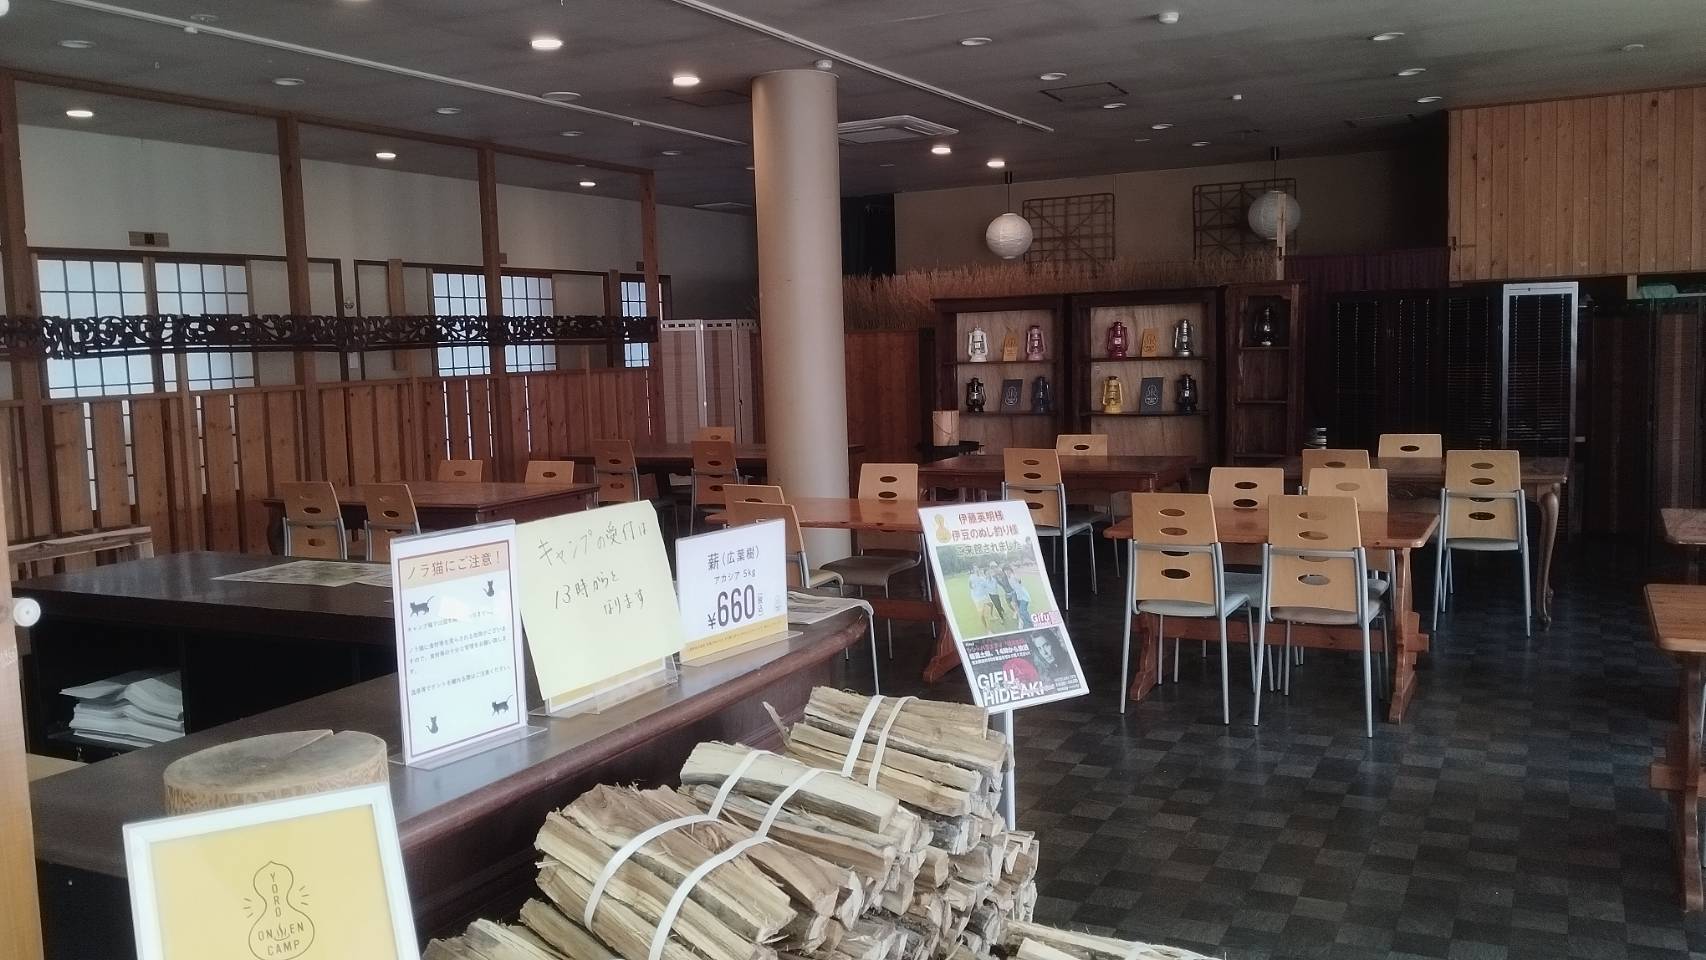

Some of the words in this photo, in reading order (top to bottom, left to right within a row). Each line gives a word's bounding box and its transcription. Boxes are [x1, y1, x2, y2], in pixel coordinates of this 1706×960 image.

[538, 520, 646, 566] キャンプの受付は
[601, 589, 643, 616] なります
[270, 871, 281, 918] YORO
[267, 939, 300, 956] CAMP
